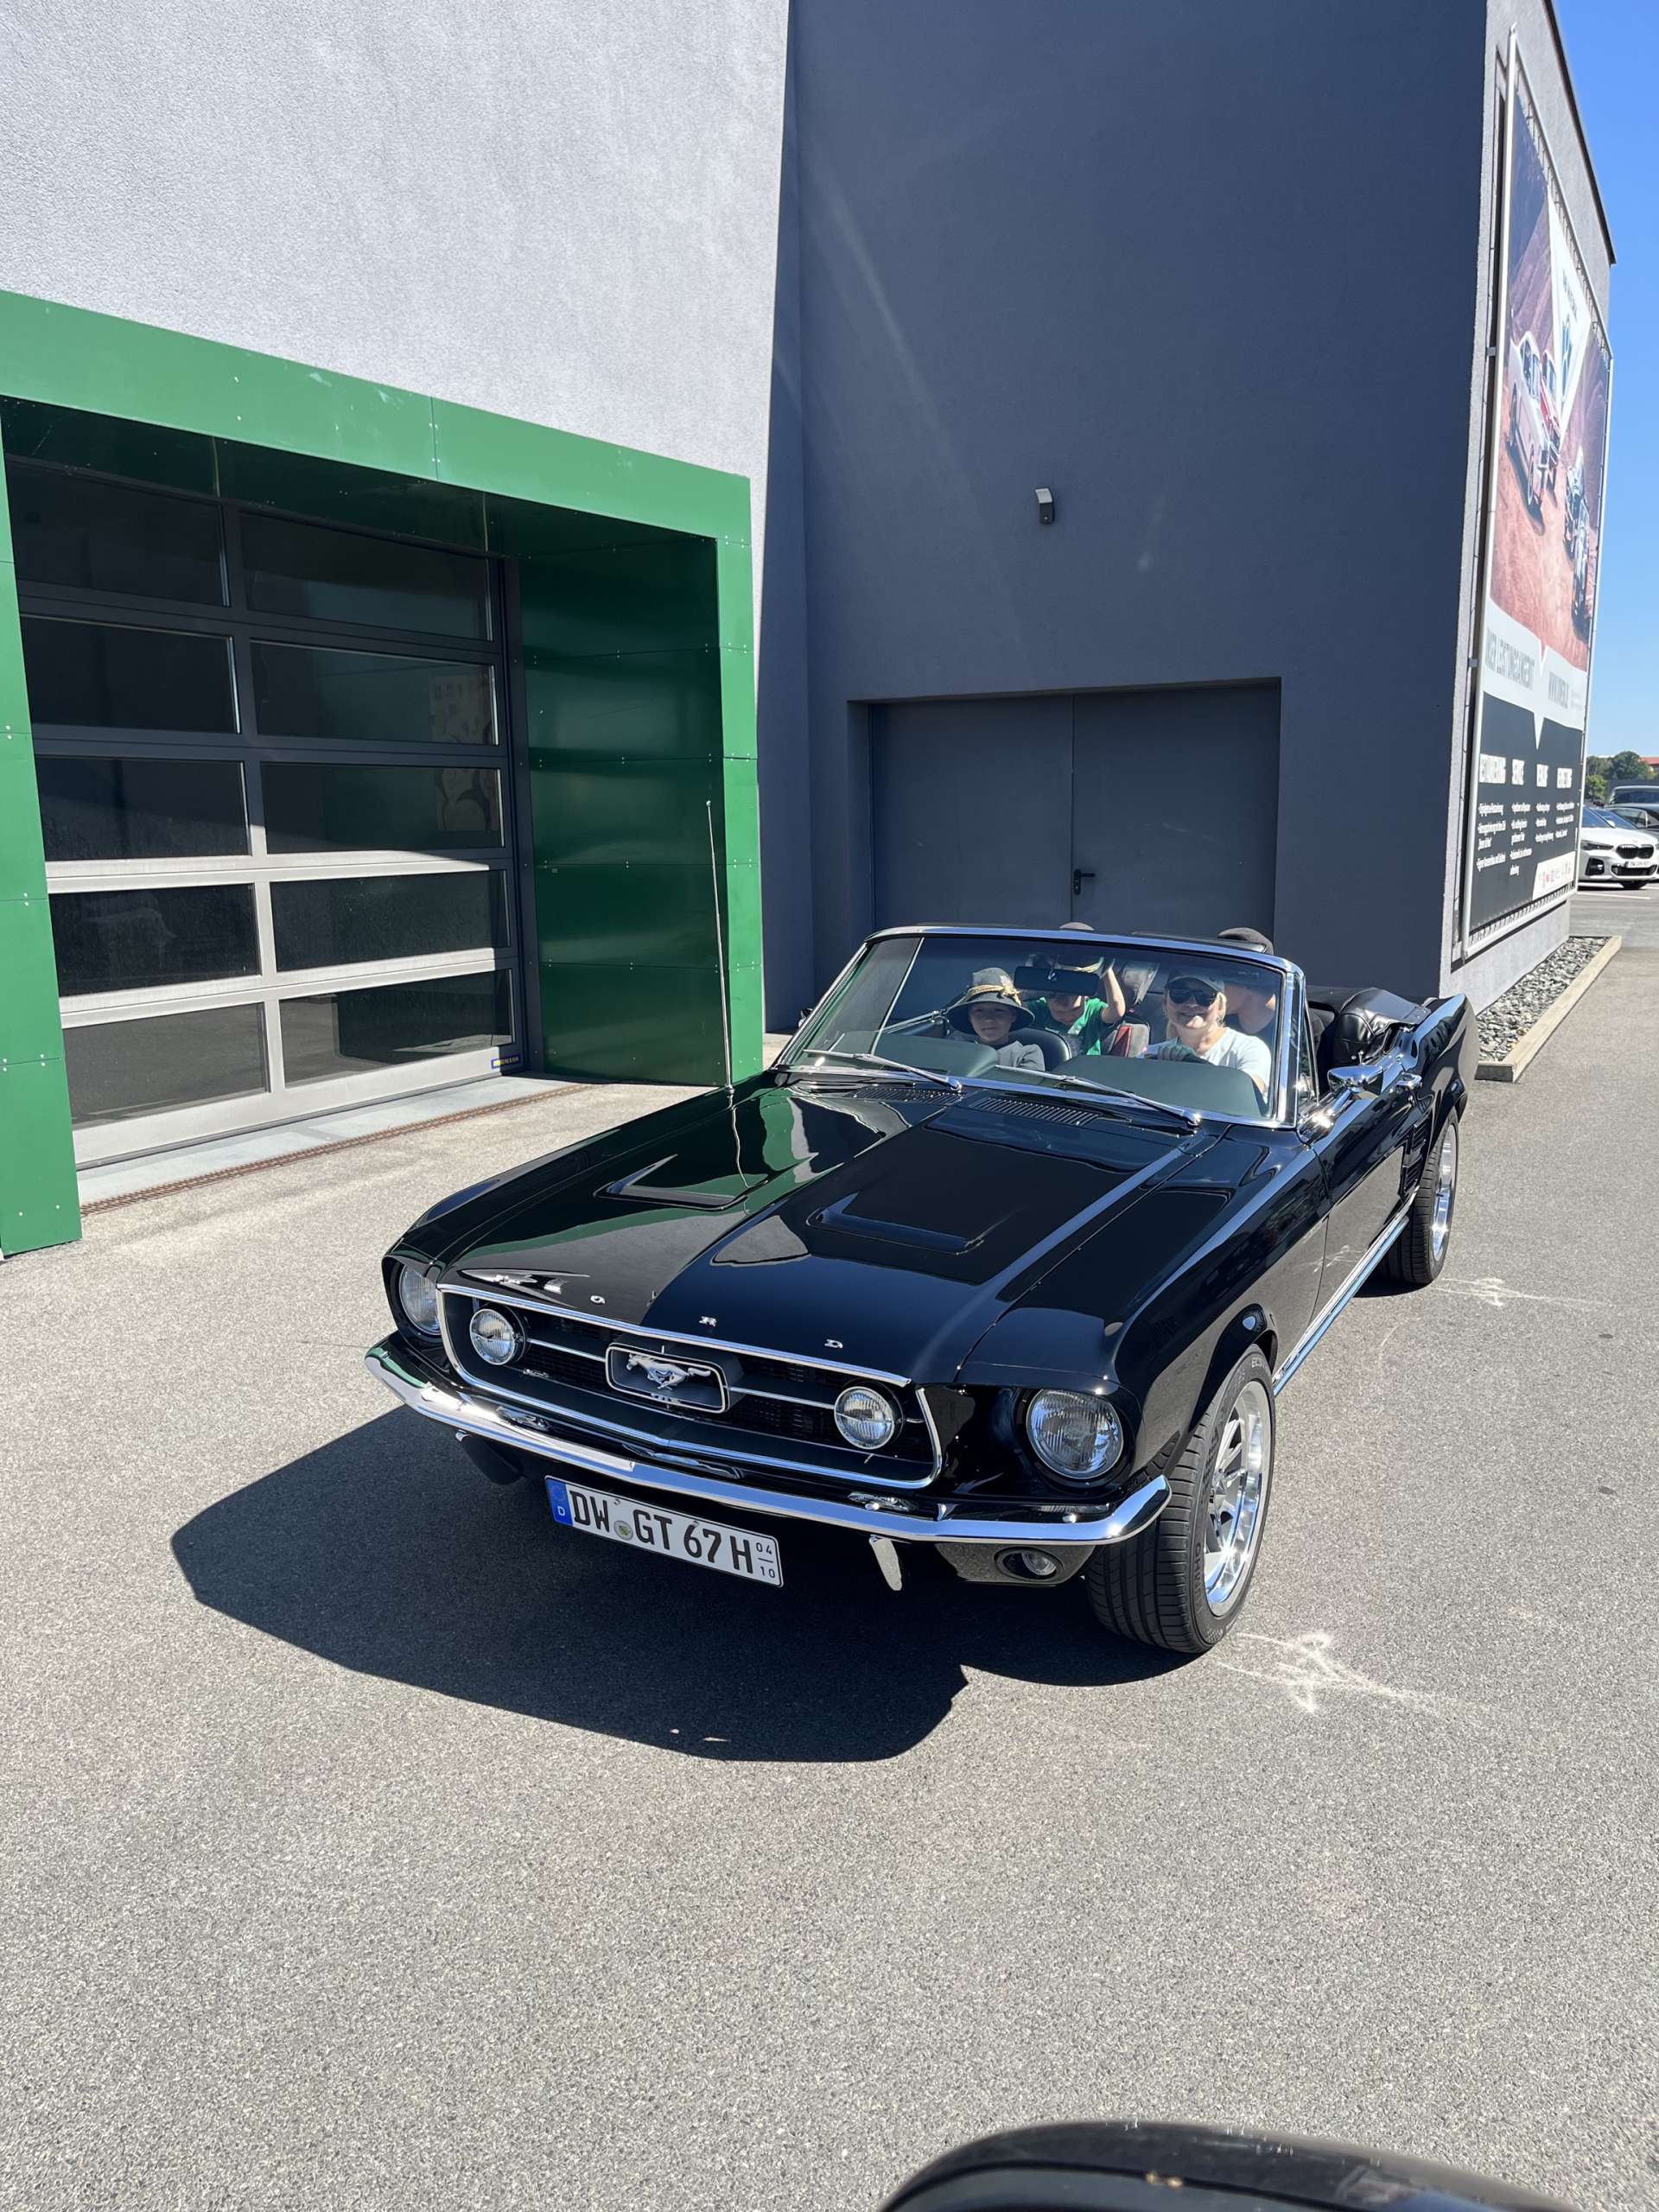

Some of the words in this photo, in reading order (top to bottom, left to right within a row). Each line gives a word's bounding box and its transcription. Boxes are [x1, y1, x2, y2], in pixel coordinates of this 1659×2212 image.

[557, 1506, 566, 1516] D
[569, 1490, 610, 1533] DW
[632, 1509, 672, 1550] GT
[755, 1541, 773, 1555] 04
[760, 1566, 776, 1580] 10
